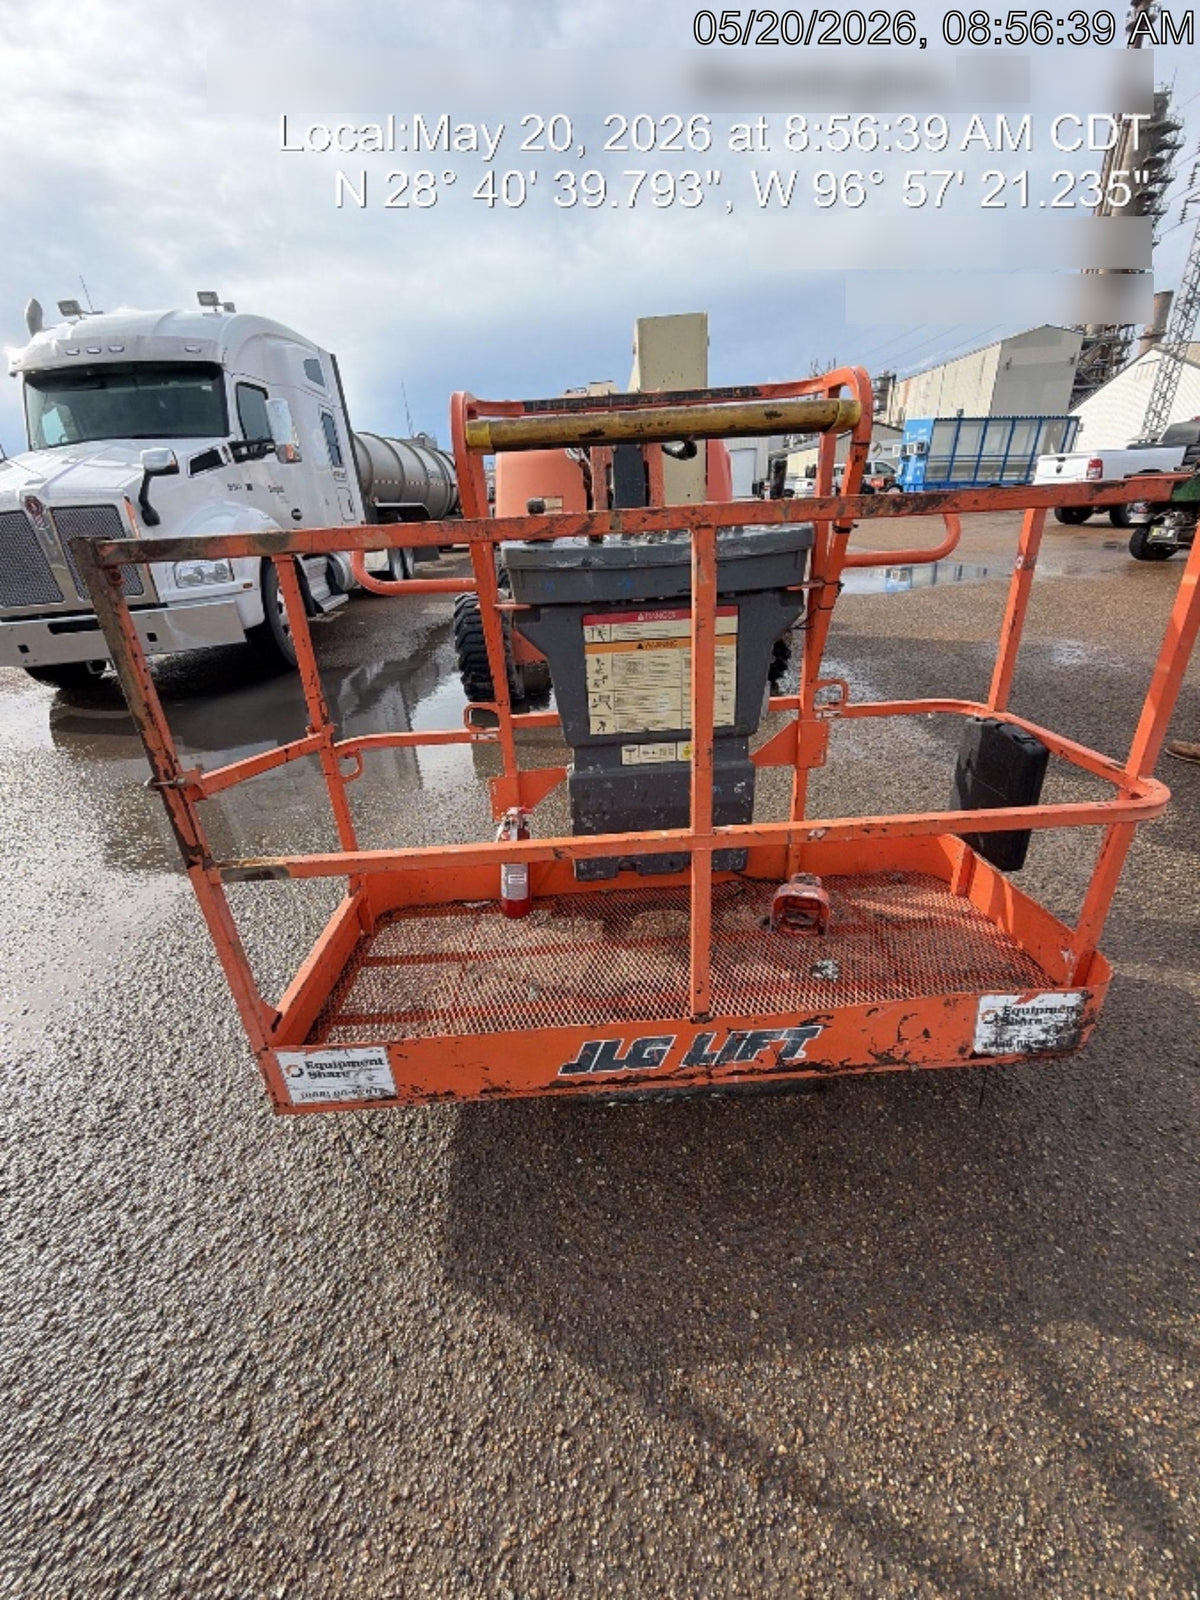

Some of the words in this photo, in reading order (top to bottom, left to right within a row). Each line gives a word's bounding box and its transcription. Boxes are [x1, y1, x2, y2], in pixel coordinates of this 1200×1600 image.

[558, 1034, 678, 1077] JLG
[680, 1025, 824, 1068] LIFT
[304, 1057, 385, 1071] Equipment
[307, 1069, 351, 1080] Share
